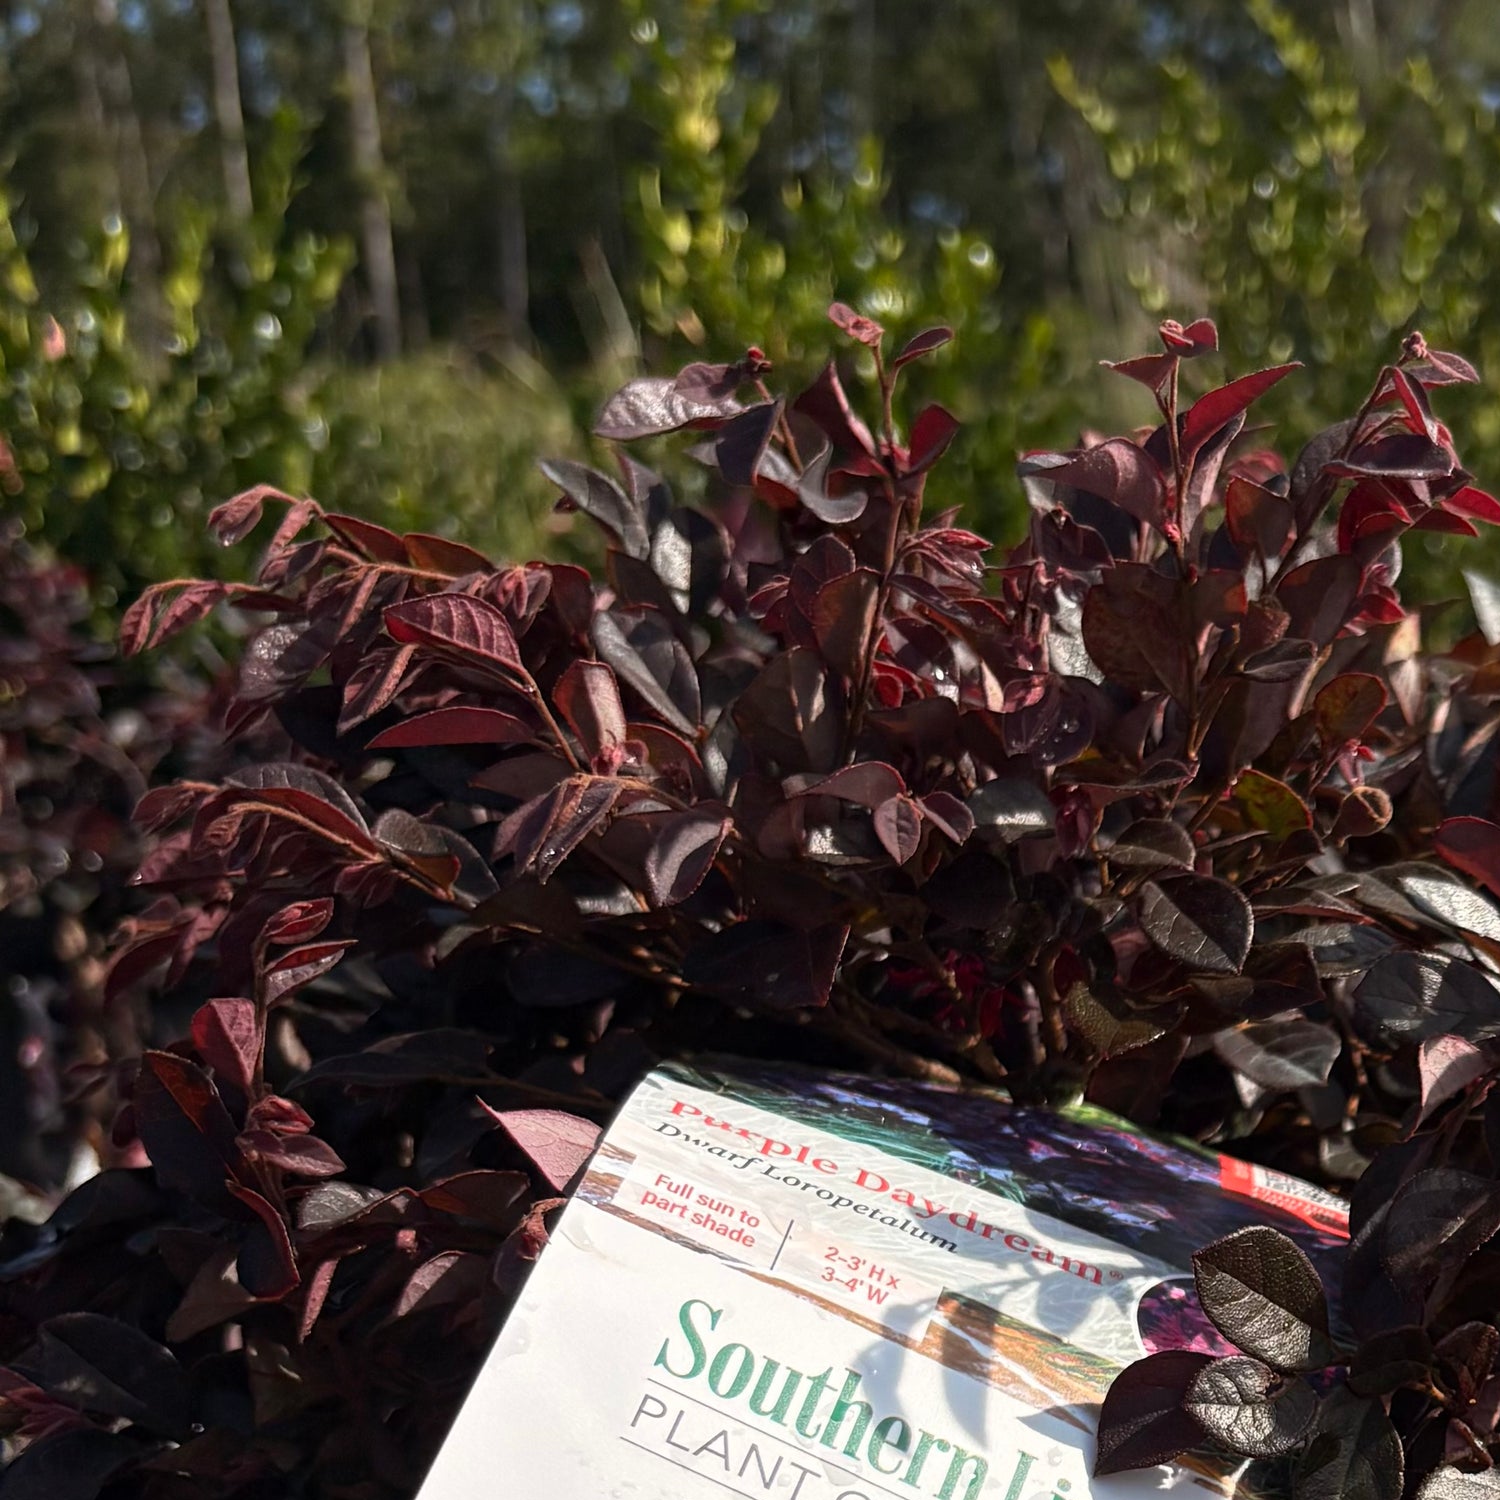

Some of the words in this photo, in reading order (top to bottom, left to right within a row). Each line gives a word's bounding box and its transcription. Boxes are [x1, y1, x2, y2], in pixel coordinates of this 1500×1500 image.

[669, 1099, 838, 1175] Purple
[654, 1121, 761, 1170] Dwarf
[760, 1165, 959, 1254] Loropetalum
[655, 1174, 695, 1203] Full
[698, 1192, 737, 1219] sun
[740, 1209, 760, 1228] to
[641, 1190, 689, 1219] part
[691, 1208, 755, 1248] shade
[867, 1285, 889, 1305] W
[868, 1265, 885, 1284] H
[887, 1275, 901, 1289] x
